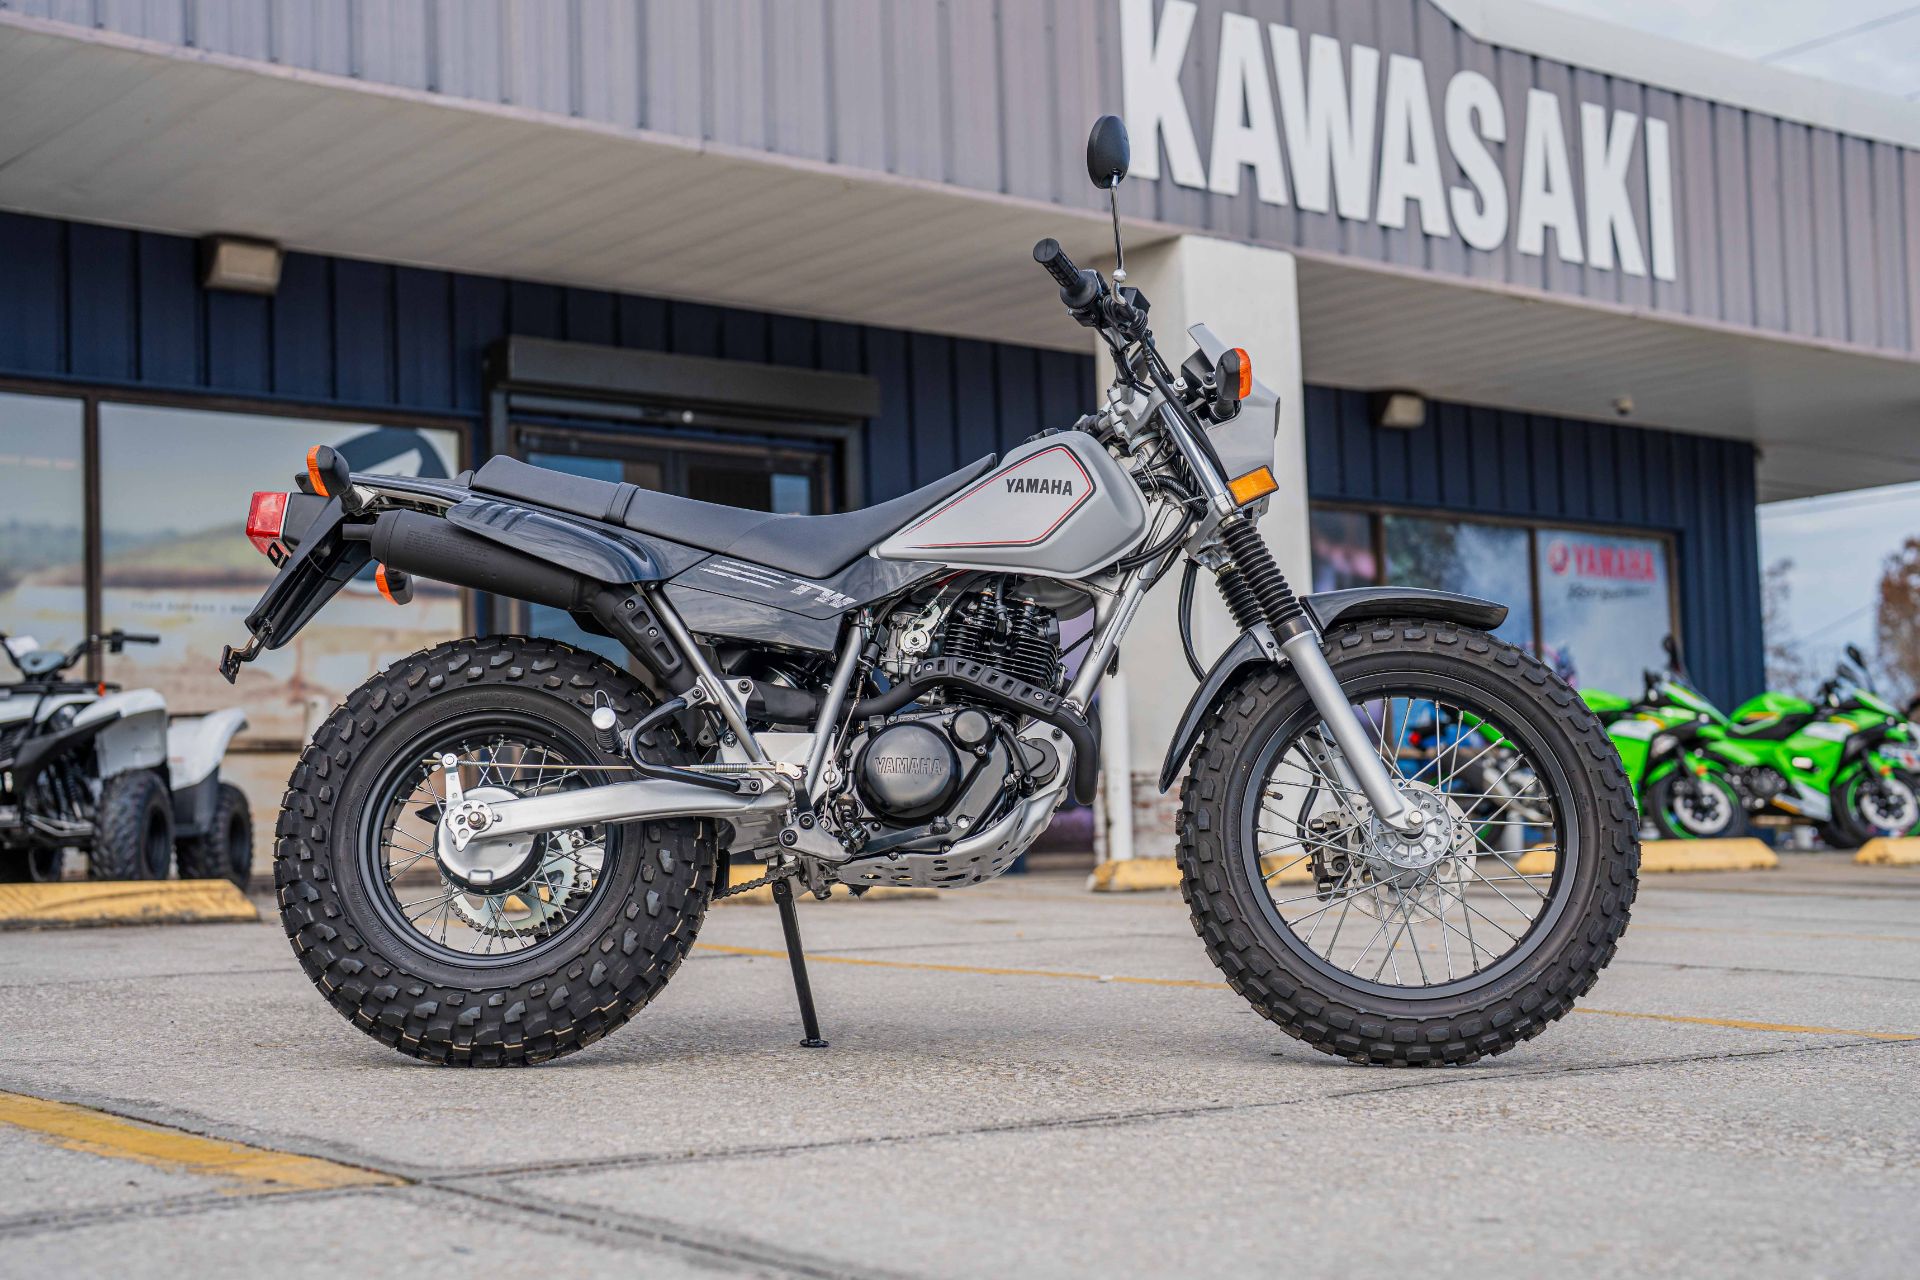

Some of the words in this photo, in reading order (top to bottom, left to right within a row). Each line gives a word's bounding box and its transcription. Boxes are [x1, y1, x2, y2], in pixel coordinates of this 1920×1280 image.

[1119, 0, 1676, 282] KAWASAKI
[1005, 478, 1073, 497] YAMAHA
[1571, 543, 1657, 583] YAMAHA
[874, 757, 942, 776] YAMAHA
